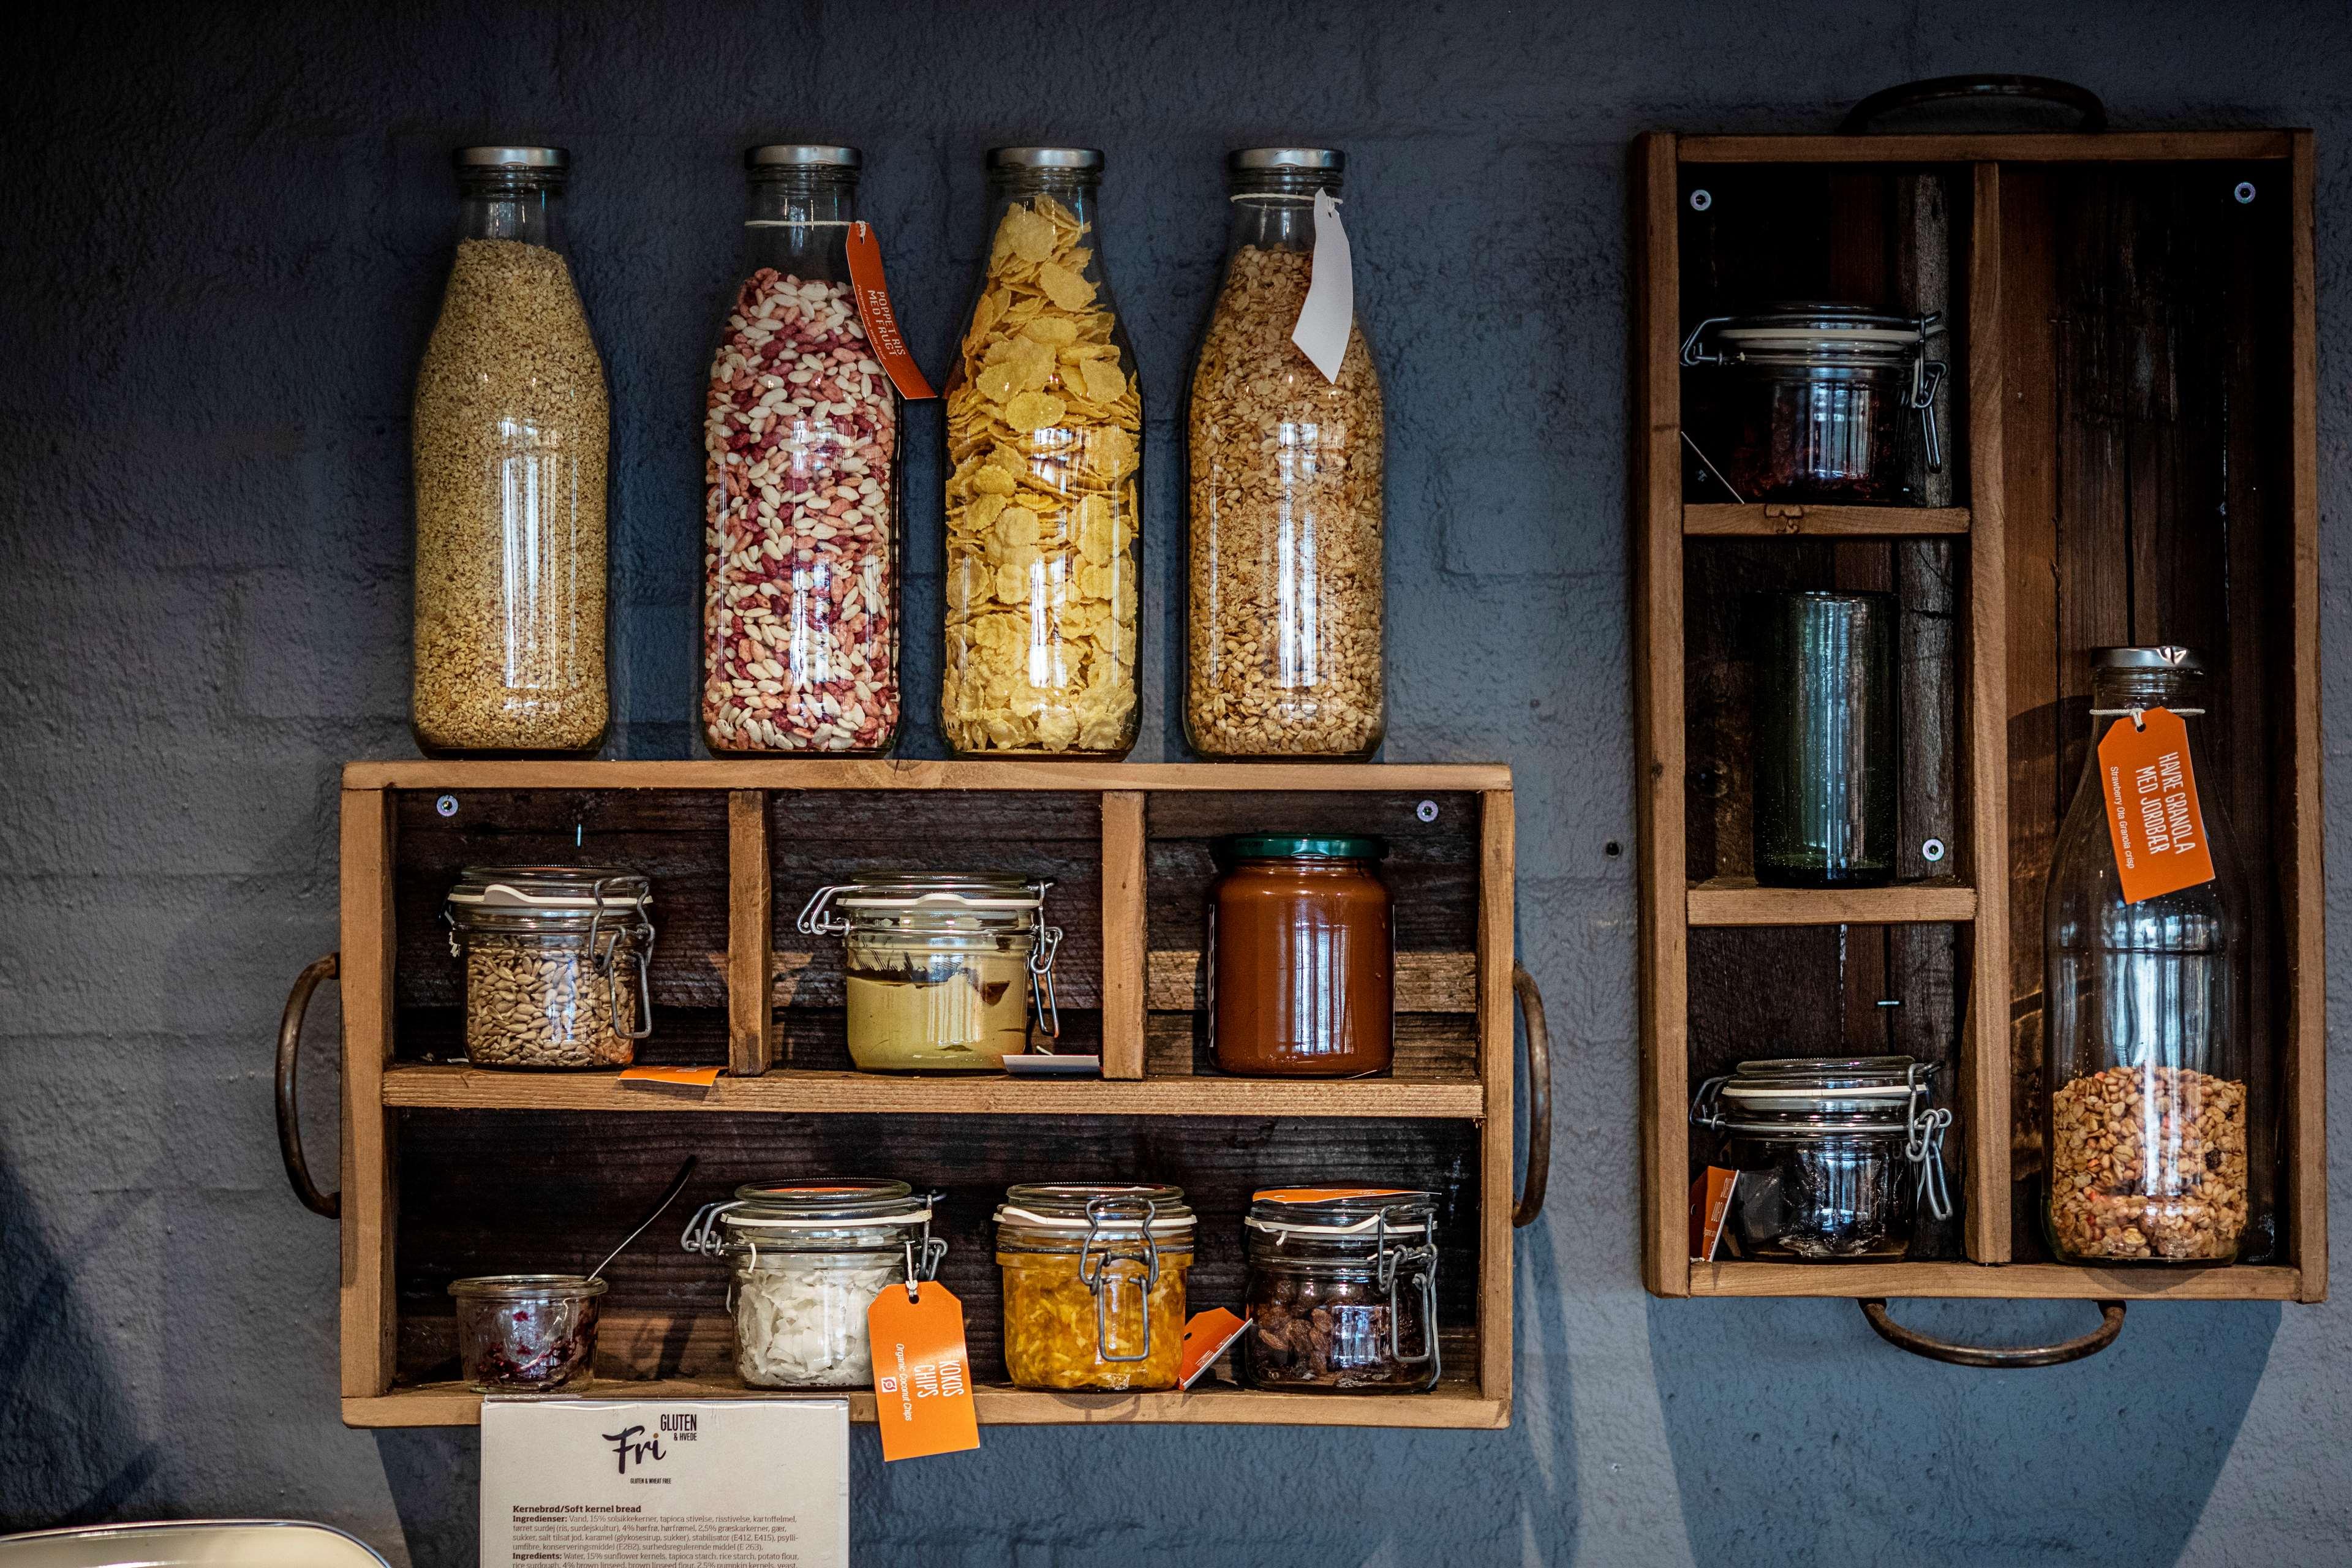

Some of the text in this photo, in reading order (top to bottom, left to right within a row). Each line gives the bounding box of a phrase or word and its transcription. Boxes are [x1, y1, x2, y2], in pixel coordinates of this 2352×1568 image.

[867, 289, 898, 356] MED FRUGT
[876, 291, 906, 356] POPPET RIS
[2110, 766, 2123, 805] Strawberry
[2119, 821, 2131, 849] Granola
[2125, 850, 2135, 869] crisp
[2135, 765, 2171, 855] MED JORDBÆR
[2158, 751, 2196, 855] HAVRE GRANOLA
[895, 1343, 912, 1421] Organic Coconut Chips
[914, 1365, 938, 1398] CHIPS
[939, 1360, 964, 1396] KOKOS
[601, 1425, 666, 1475] Fri
[660, 1414, 697, 1431] GLUTEN
[679, 1433, 698, 1441] HVEDE
